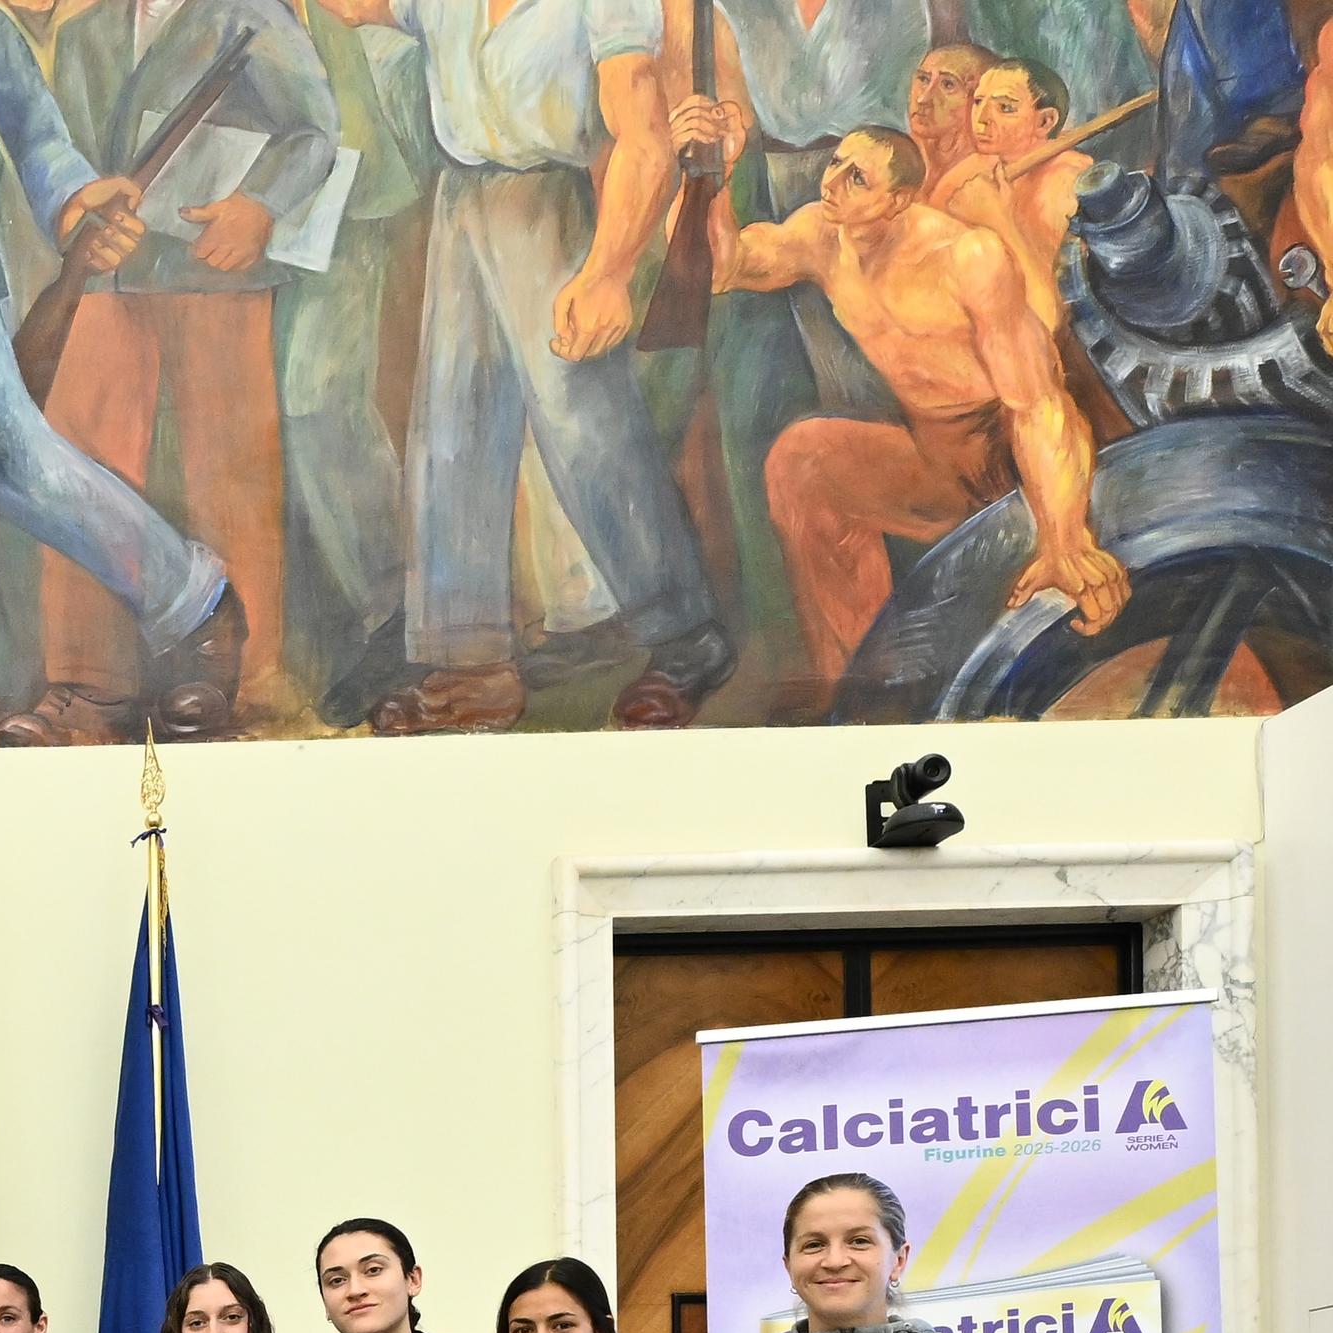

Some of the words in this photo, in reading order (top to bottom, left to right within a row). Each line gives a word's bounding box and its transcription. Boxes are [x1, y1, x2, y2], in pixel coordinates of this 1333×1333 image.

[727, 1084, 1100, 1158] Calciatrici
[1125, 1142, 1179, 1152] WOMEN
[1127, 1135, 1165, 1144] SERIE
[1166, 1134, 1176, 1142] A
[923, 1145, 1007, 1163] Figurine
[1014, 1139, 1101, 1156] 2025-2026
